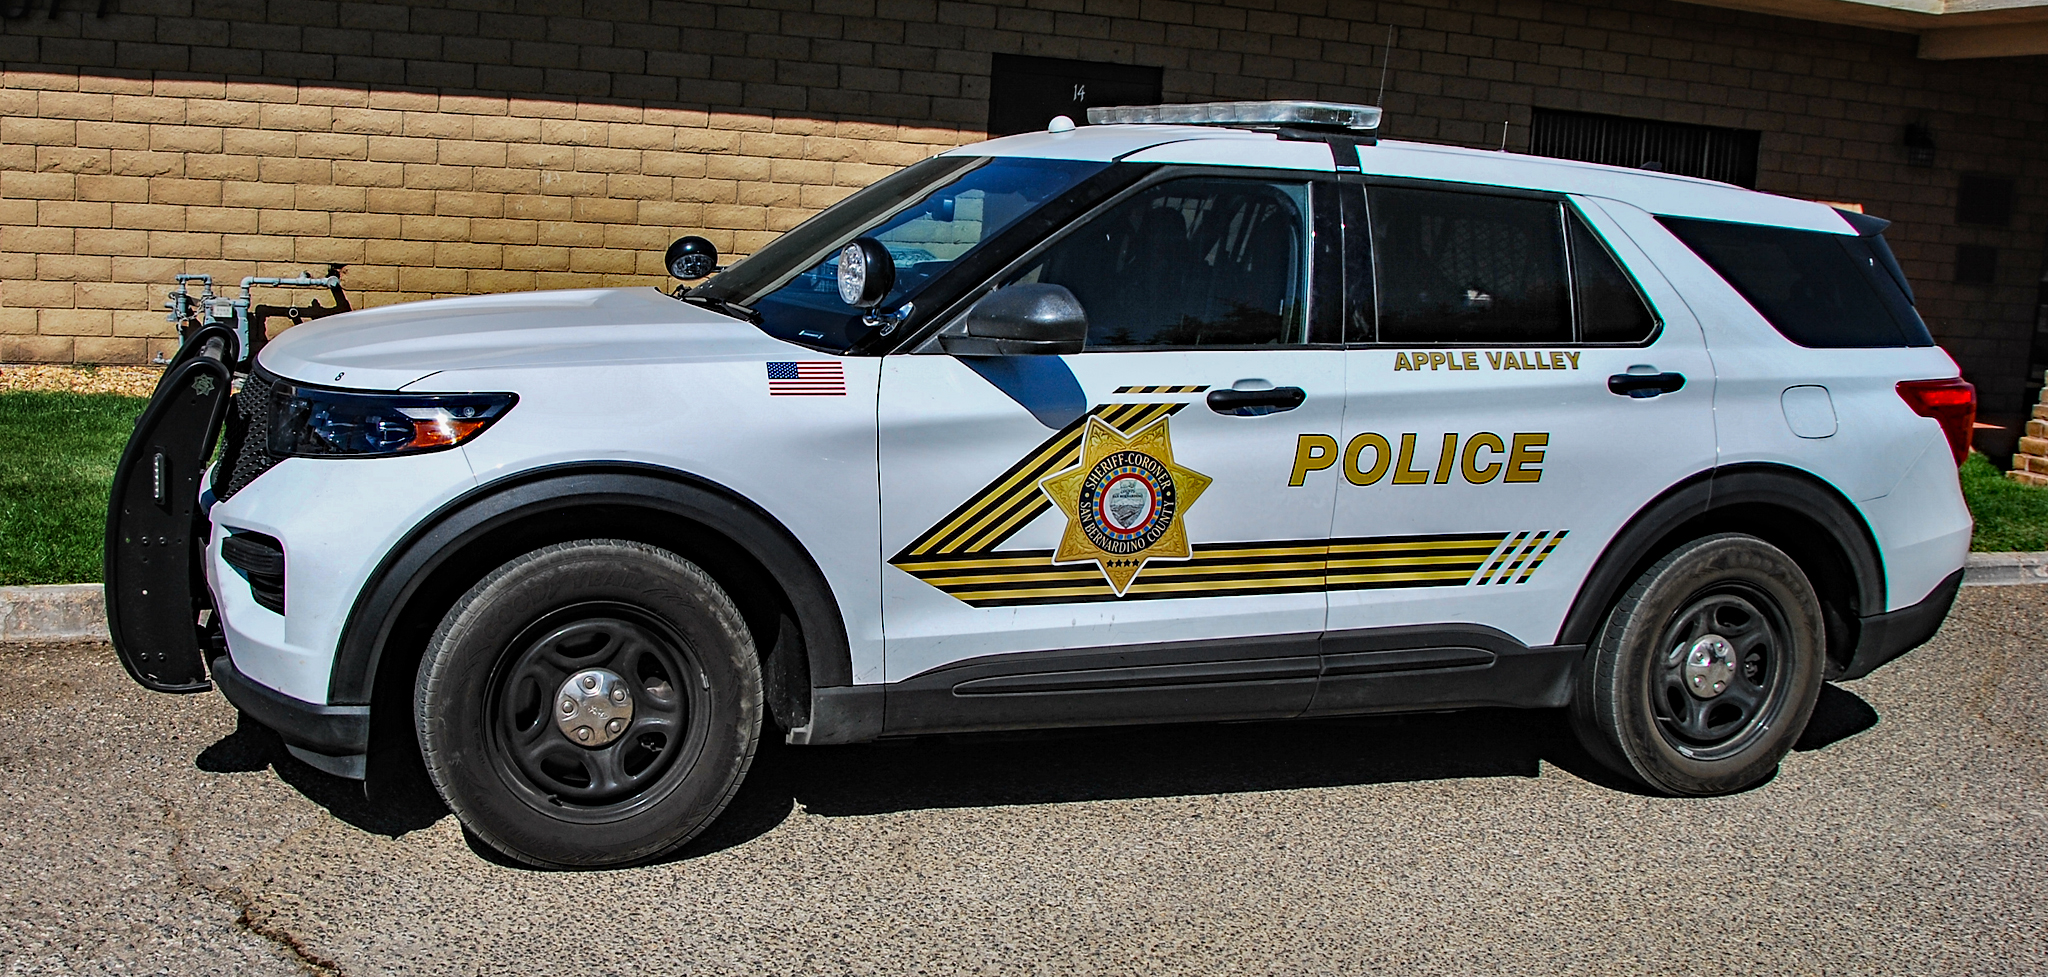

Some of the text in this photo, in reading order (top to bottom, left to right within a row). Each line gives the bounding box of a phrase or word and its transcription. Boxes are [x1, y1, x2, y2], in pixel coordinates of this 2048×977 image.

[1073, 84, 1085, 101] 14
[1394, 351, 1580, 371] APPLE VALLEY
[335, 372, 344, 381] 8
[1085, 453, 1171, 490] SHERIFF-CORONER
[1288, 432, 1550, 487] POLICE
[1080, 500, 1174, 553] SAN BERNARDINO COUNTY
